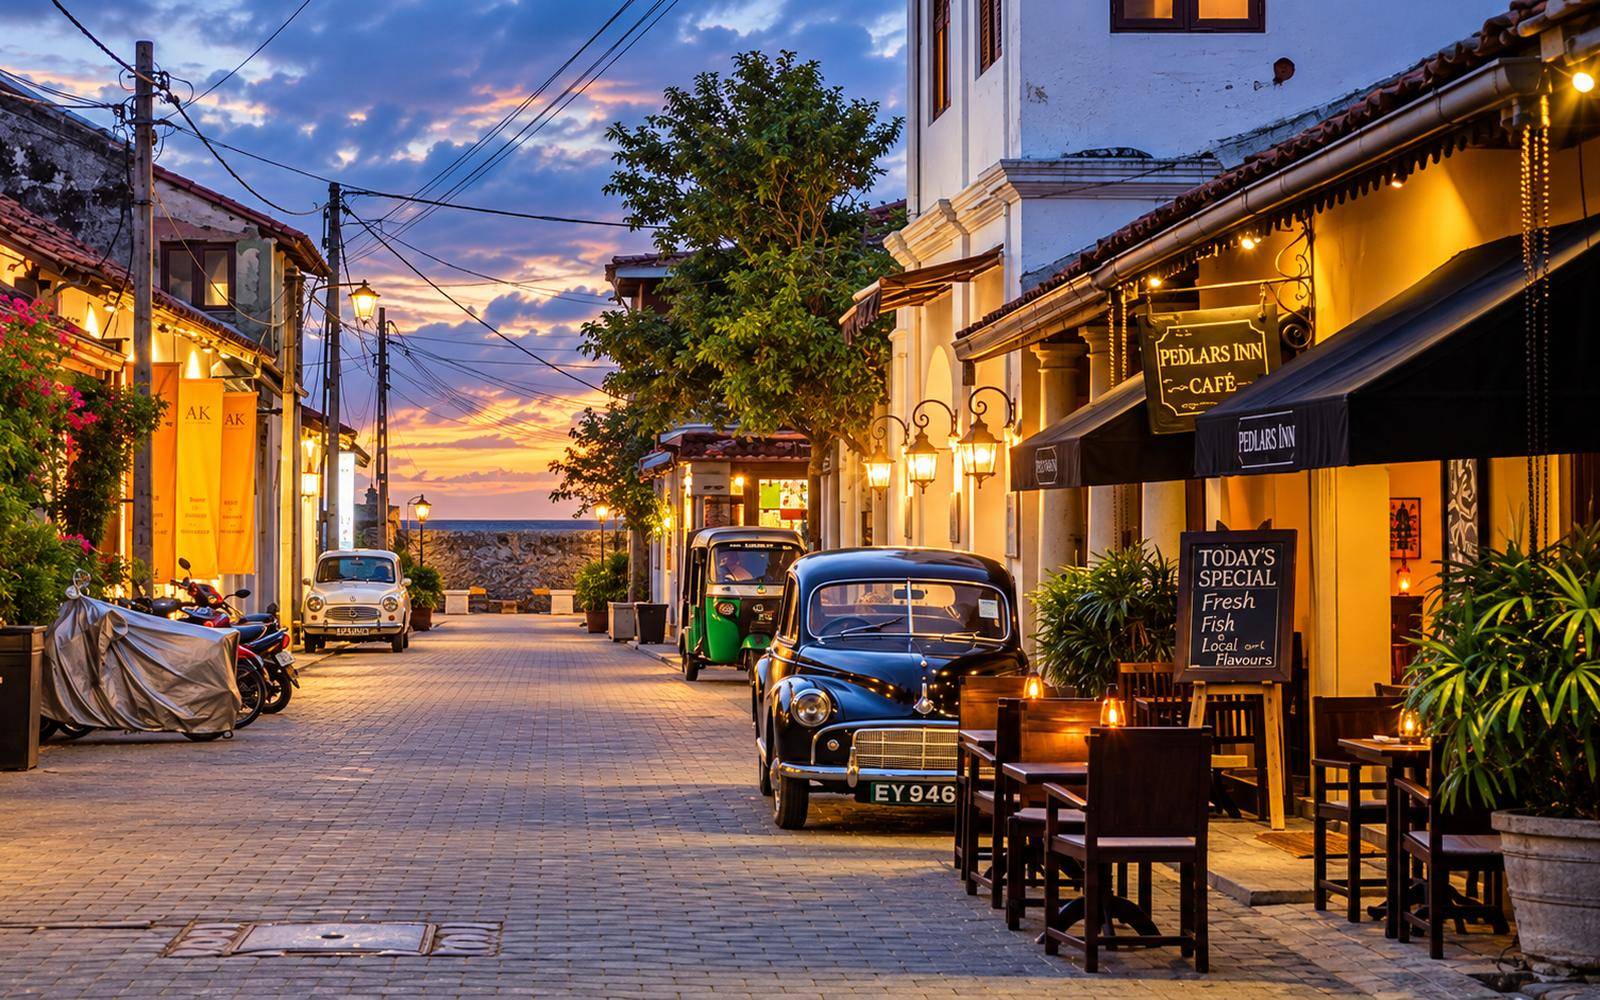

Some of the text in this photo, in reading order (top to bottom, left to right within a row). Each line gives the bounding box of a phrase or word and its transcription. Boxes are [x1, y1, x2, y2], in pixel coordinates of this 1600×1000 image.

[1160, 343, 1263, 367] PEDLARS INN
[1189, 372, 1237, 394] CAFÉ
[185, 406, 210, 420] AK
[225, 413, 245, 425] AK
[1238, 424, 1296, 453] PEDLARS INN
[1198, 548, 1276, 567] TODAY'S
[1198, 569, 1276, 588] SPECIAL
[1202, 591, 1256, 612] Fresh
[1201, 613, 1235, 632] Fish
[1202, 637, 1238, 653] Local
[1216, 653, 1272, 666] Flavours
